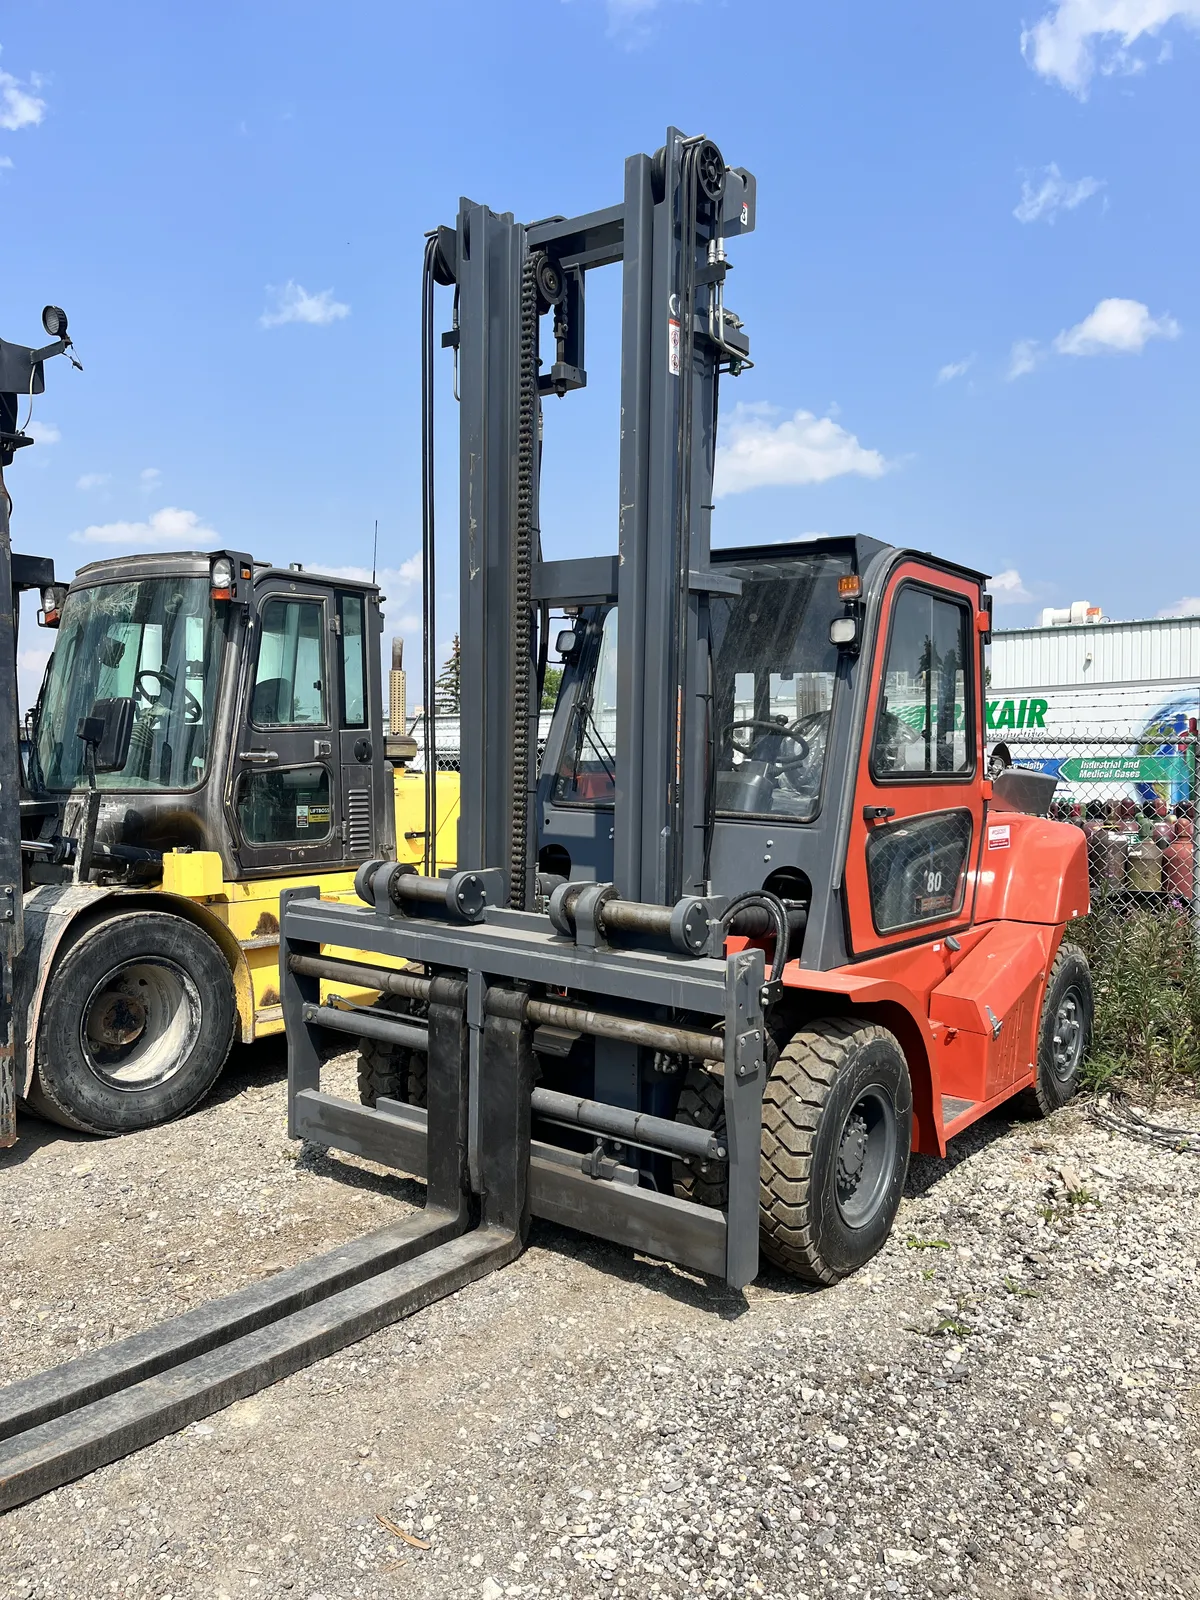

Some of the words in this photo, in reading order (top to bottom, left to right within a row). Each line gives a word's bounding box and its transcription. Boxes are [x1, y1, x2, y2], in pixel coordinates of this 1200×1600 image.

[1080, 760, 1122, 769] Industrial
[1123, 760, 1140, 769] and
[1079, 769, 1112, 778] Medical
[1114, 769, 1140, 778] Gases
